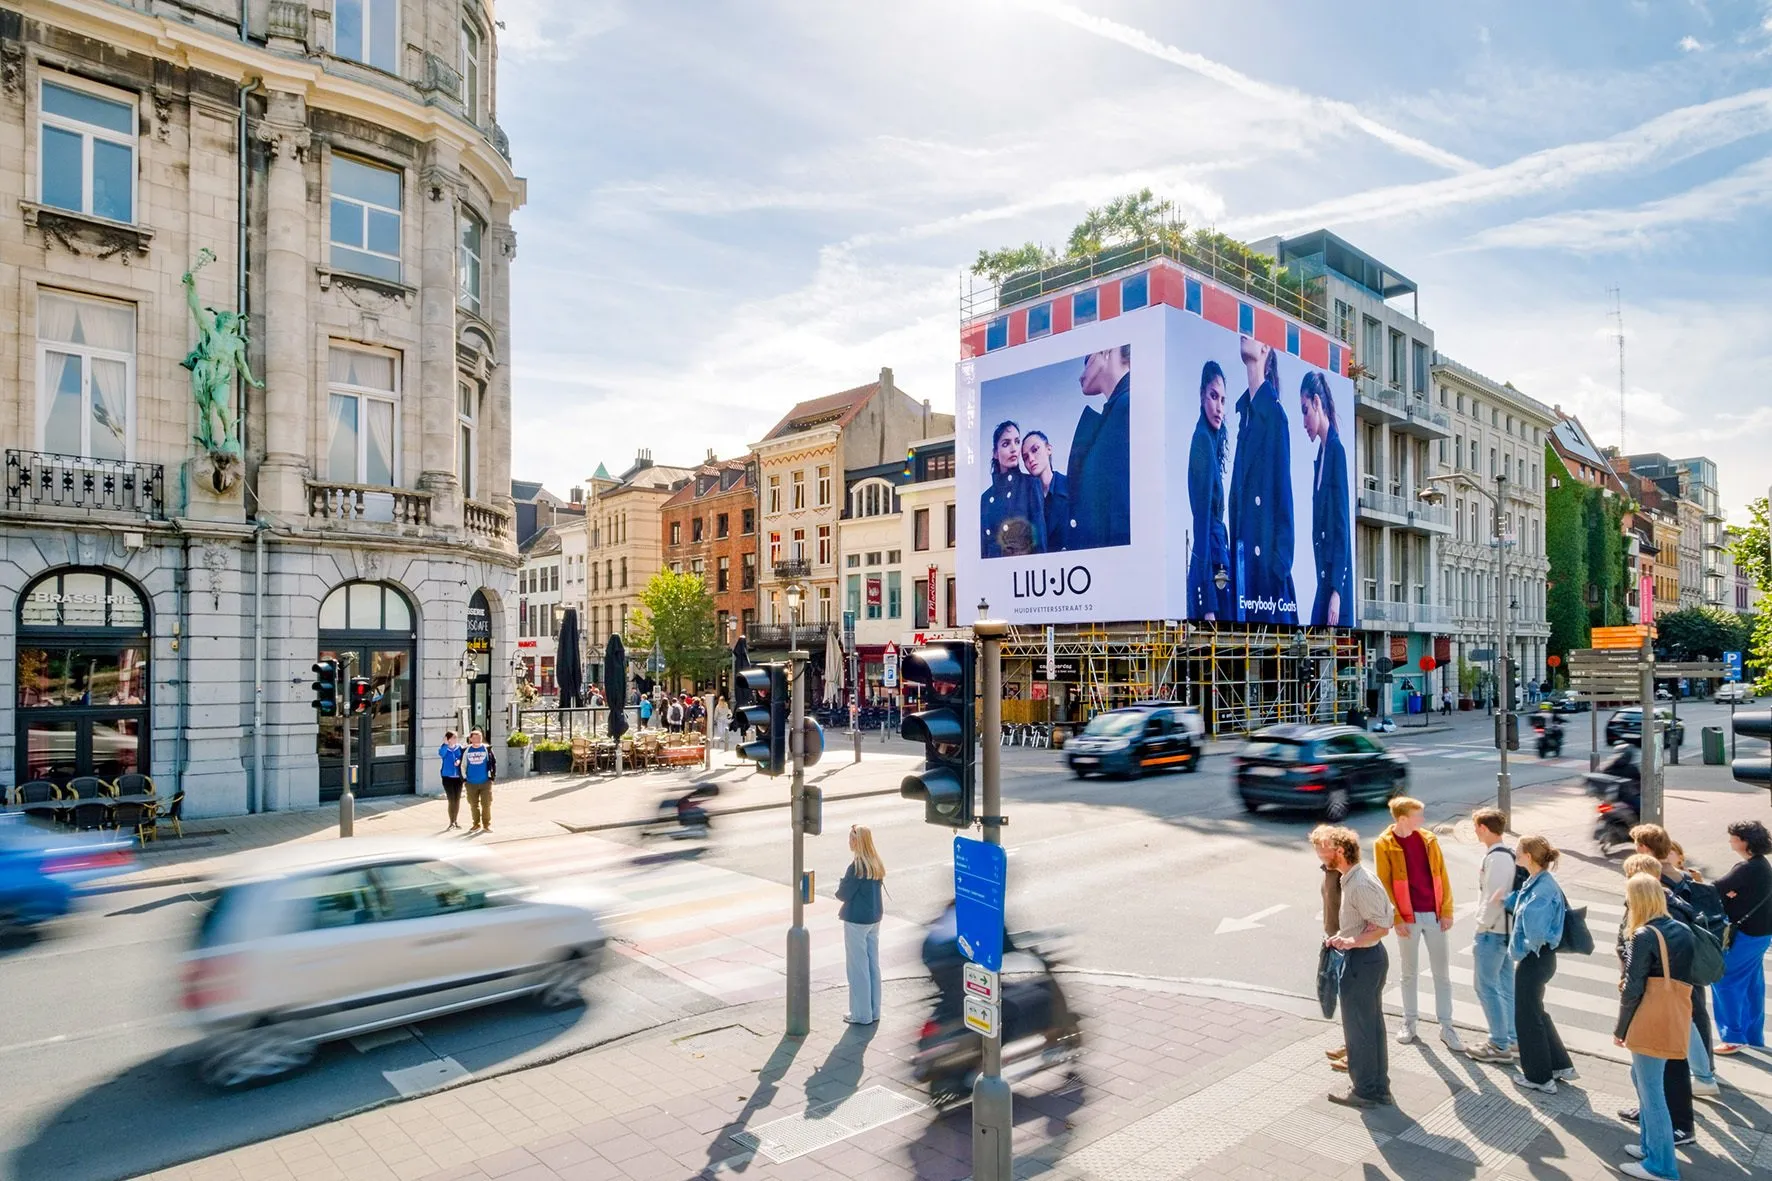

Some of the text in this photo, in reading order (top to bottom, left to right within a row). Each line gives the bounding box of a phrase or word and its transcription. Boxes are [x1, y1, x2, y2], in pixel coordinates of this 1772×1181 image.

[34, 591, 134, 605] BRASSERIE
[1013, 603, 1093, 614] HUIDEVETTERSSTRAAT 52
[1239, 594, 1297, 615] Everybody Coats
[1727, 653, 1737, 664] P
